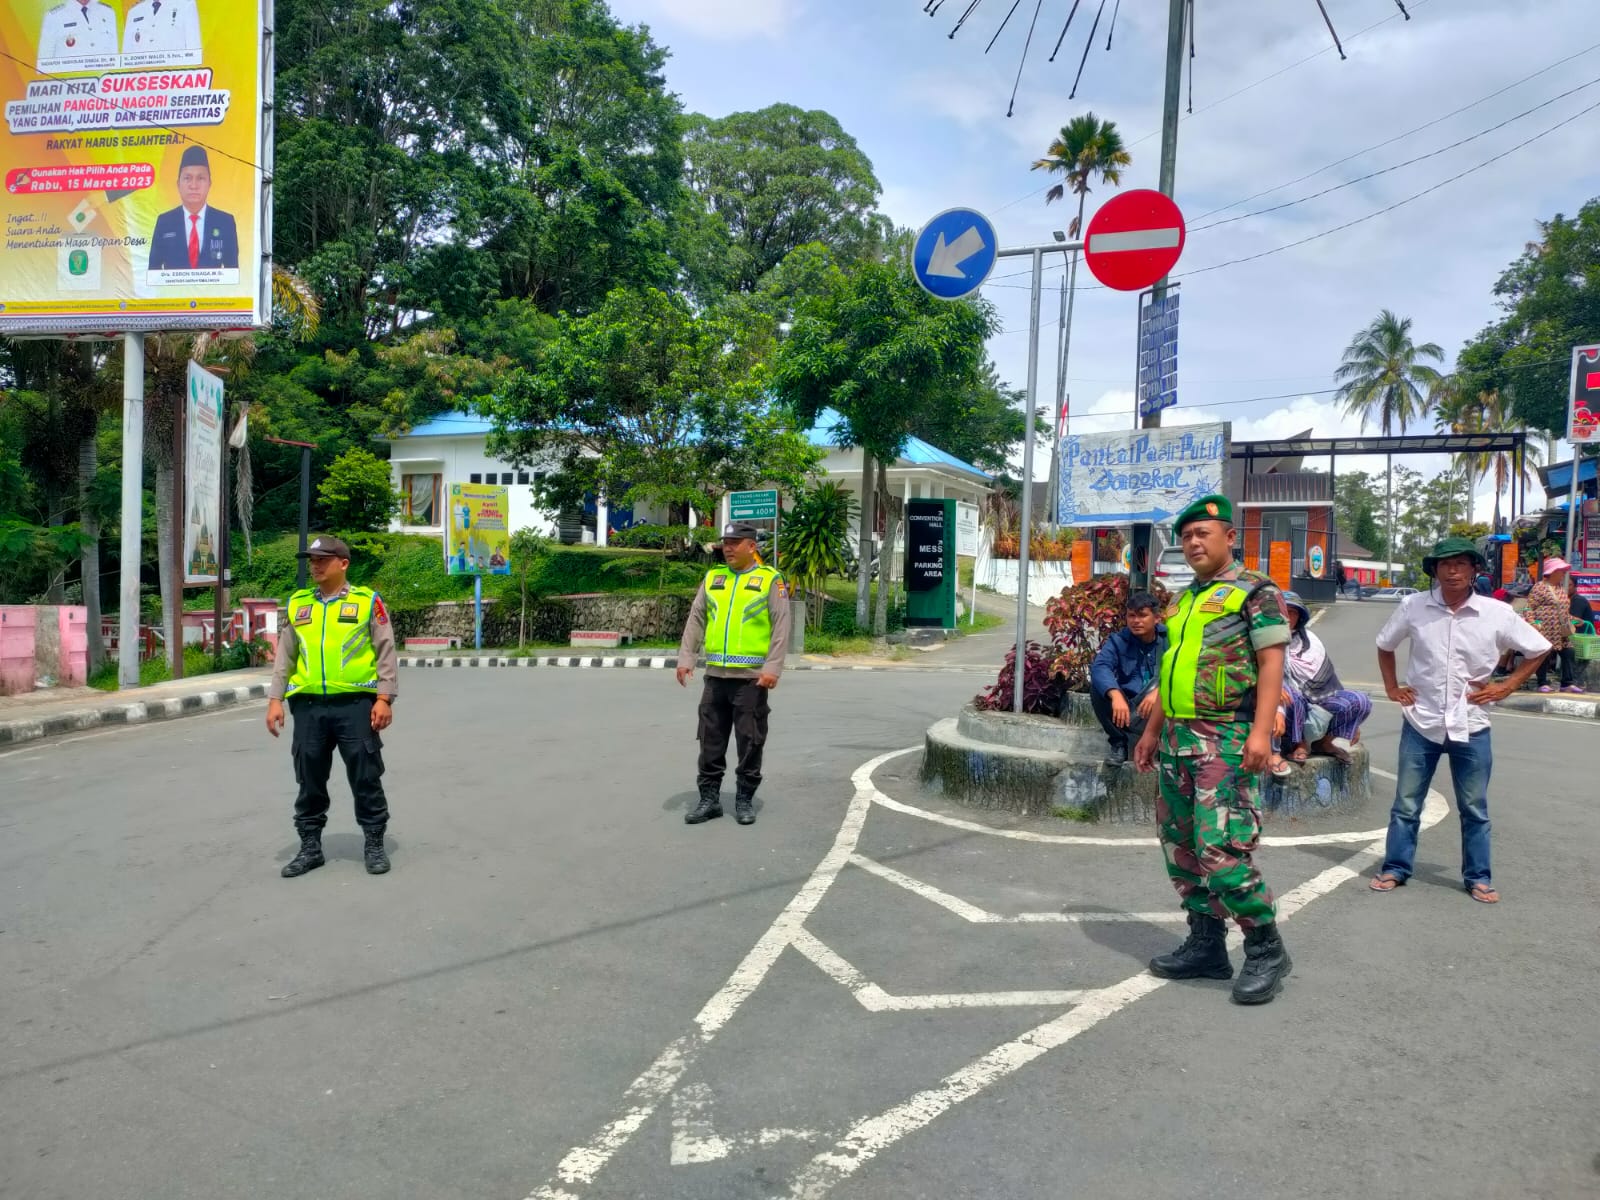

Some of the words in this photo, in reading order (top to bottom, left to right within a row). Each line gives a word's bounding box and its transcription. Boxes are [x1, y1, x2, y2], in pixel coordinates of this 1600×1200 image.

[29, 85, 62, 97] MARI
[67, 82, 97, 95] KITA
[101, 73, 208, 92] SUKSESKAN
[9, 102, 61, 115] PEMILIHAN
[63, 98, 118, 112] PANGULU
[122, 95, 168, 109] NAGORI
[170, 93, 225, 107] SERENTAK
[13, 116, 37, 128] YANG
[40, 114, 74, 127] DAMAI,
[77, 112, 109, 124] JUJUR
[115, 111, 136, 122] DAN
[138, 107, 221, 121] BERINTEGRITAS
[46, 138, 83, 150] RAKYAT
[86, 136, 119, 148] HARUS
[31, 168, 67, 178] Gunakan
[69, 168, 85, 176] Hak
[86, 166, 105, 175] Pilih
[107, 165, 128, 174] Anda
[130, 164, 151, 173] Pada
[31, 180, 63, 191] Rabu,
[68, 178, 79, 189] 15
[83, 177, 118, 188] Maret
[122, 176, 152, 187] 2023
[6, 227, 33, 237] Suara
[36, 225, 61, 236] Anda
[6, 239, 62, 249] Menentukan
[65, 237, 90, 248] Masa
[92, 236, 121, 249] Depan
[124, 236, 147, 247] Desa
[1068, 441, 1134, 467] Pantai
[1179, 433, 1225, 461] Putih
[919, 545, 943, 553] MESS
